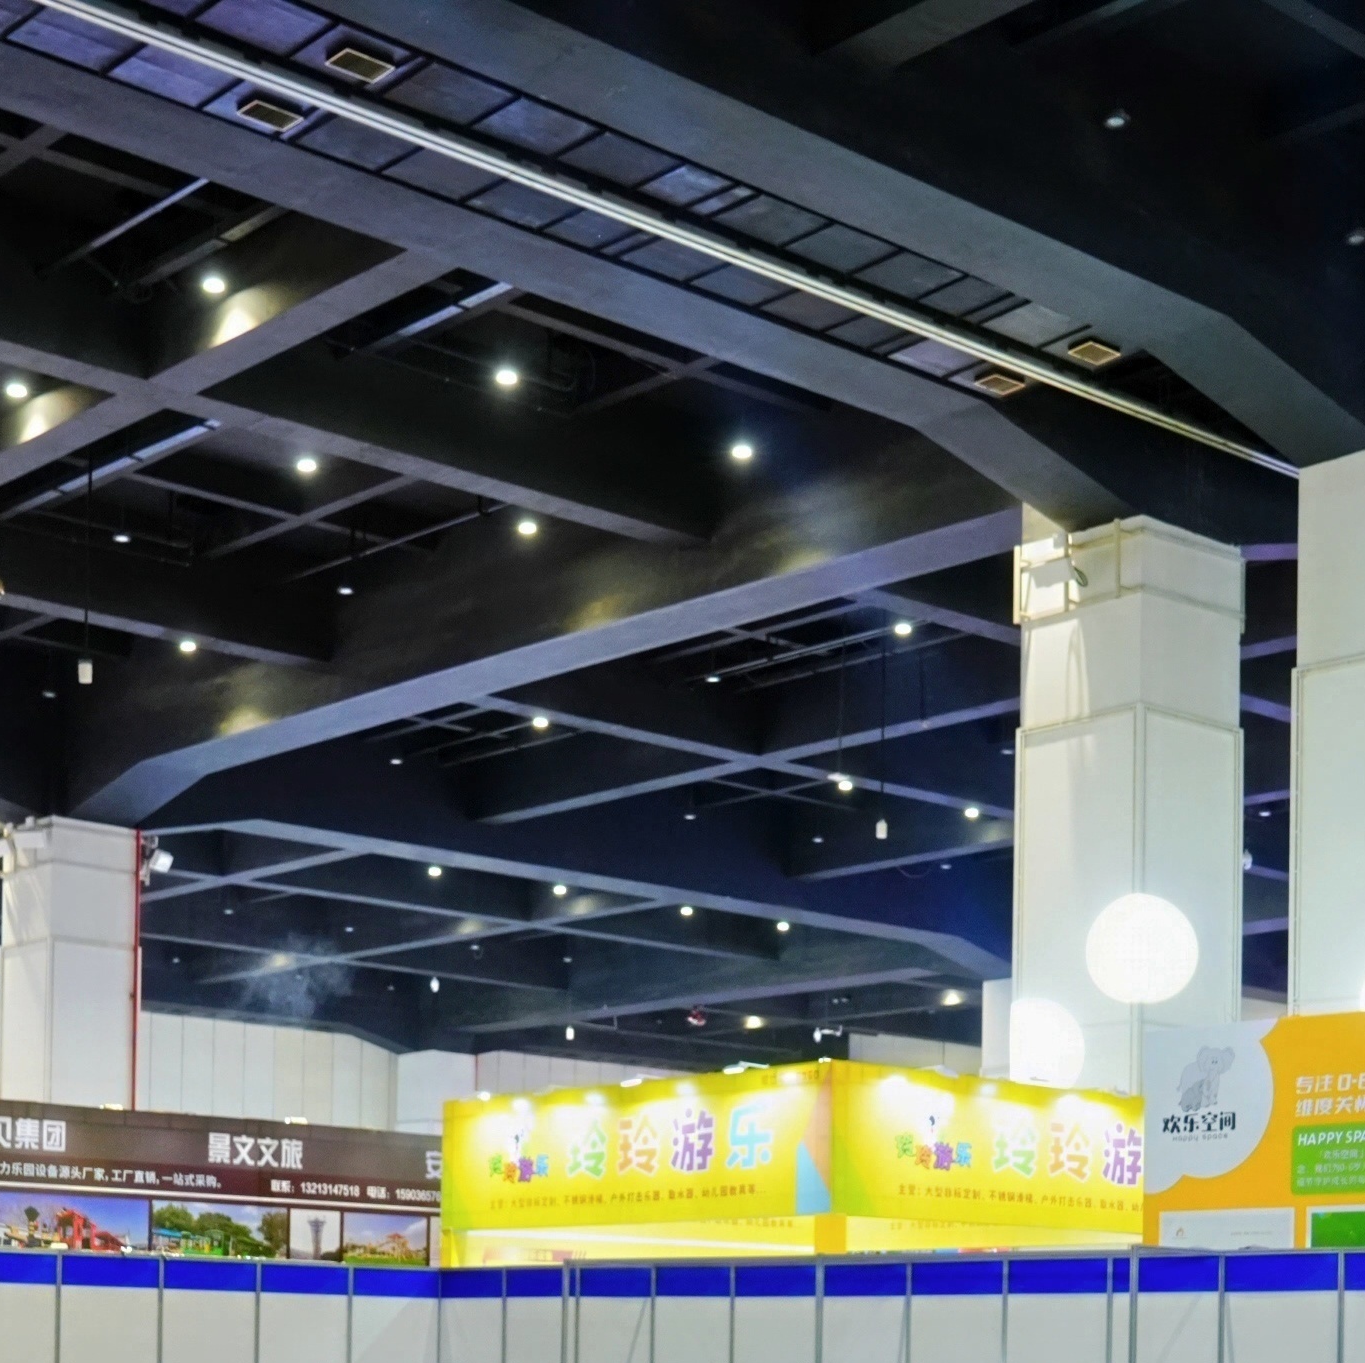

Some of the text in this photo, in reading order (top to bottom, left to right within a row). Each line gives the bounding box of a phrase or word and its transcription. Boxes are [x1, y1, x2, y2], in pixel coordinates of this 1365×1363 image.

[1162, 1111, 1237, 1134] 欢乐空间
[207, 1131, 304, 1170] 景文文旅
[567, 1102, 773, 1178] 玲玲游乐
[1297, 1131, 1343, 1147] HAPPY
